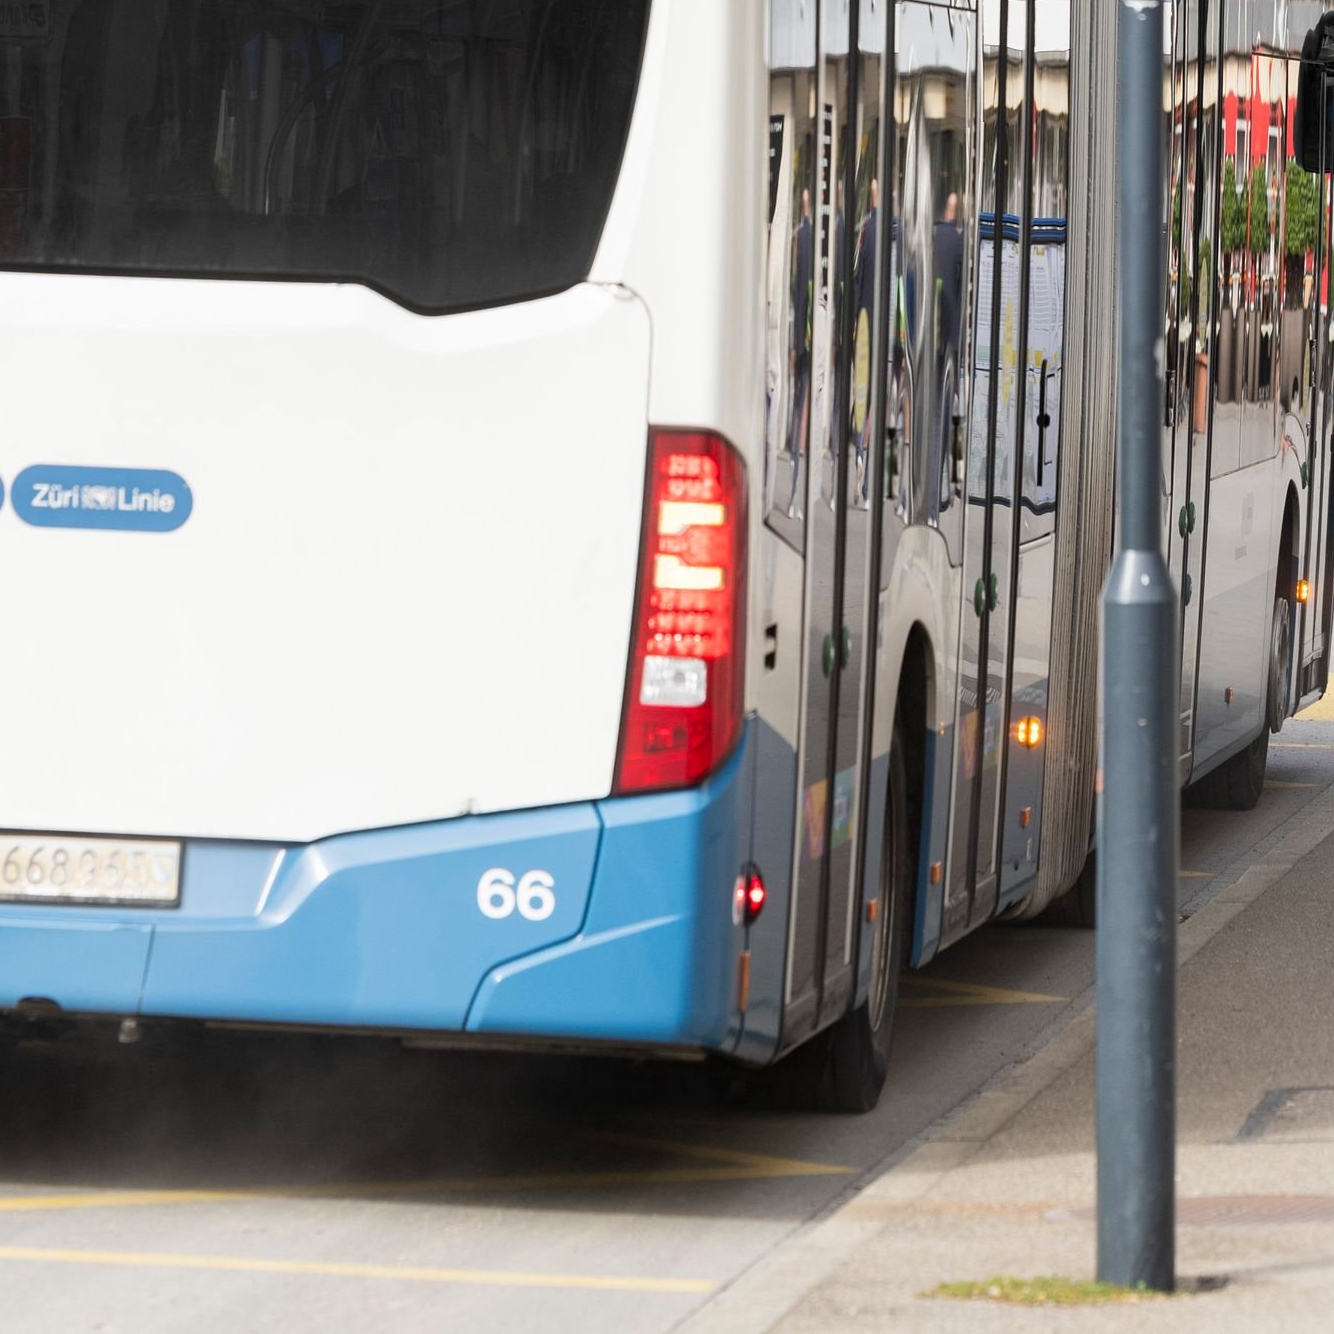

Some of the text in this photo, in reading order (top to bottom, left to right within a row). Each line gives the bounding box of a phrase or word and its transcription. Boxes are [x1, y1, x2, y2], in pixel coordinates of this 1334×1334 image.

[31, 482, 176, 514] Züri Linie
[476, 867, 556, 922] 66
